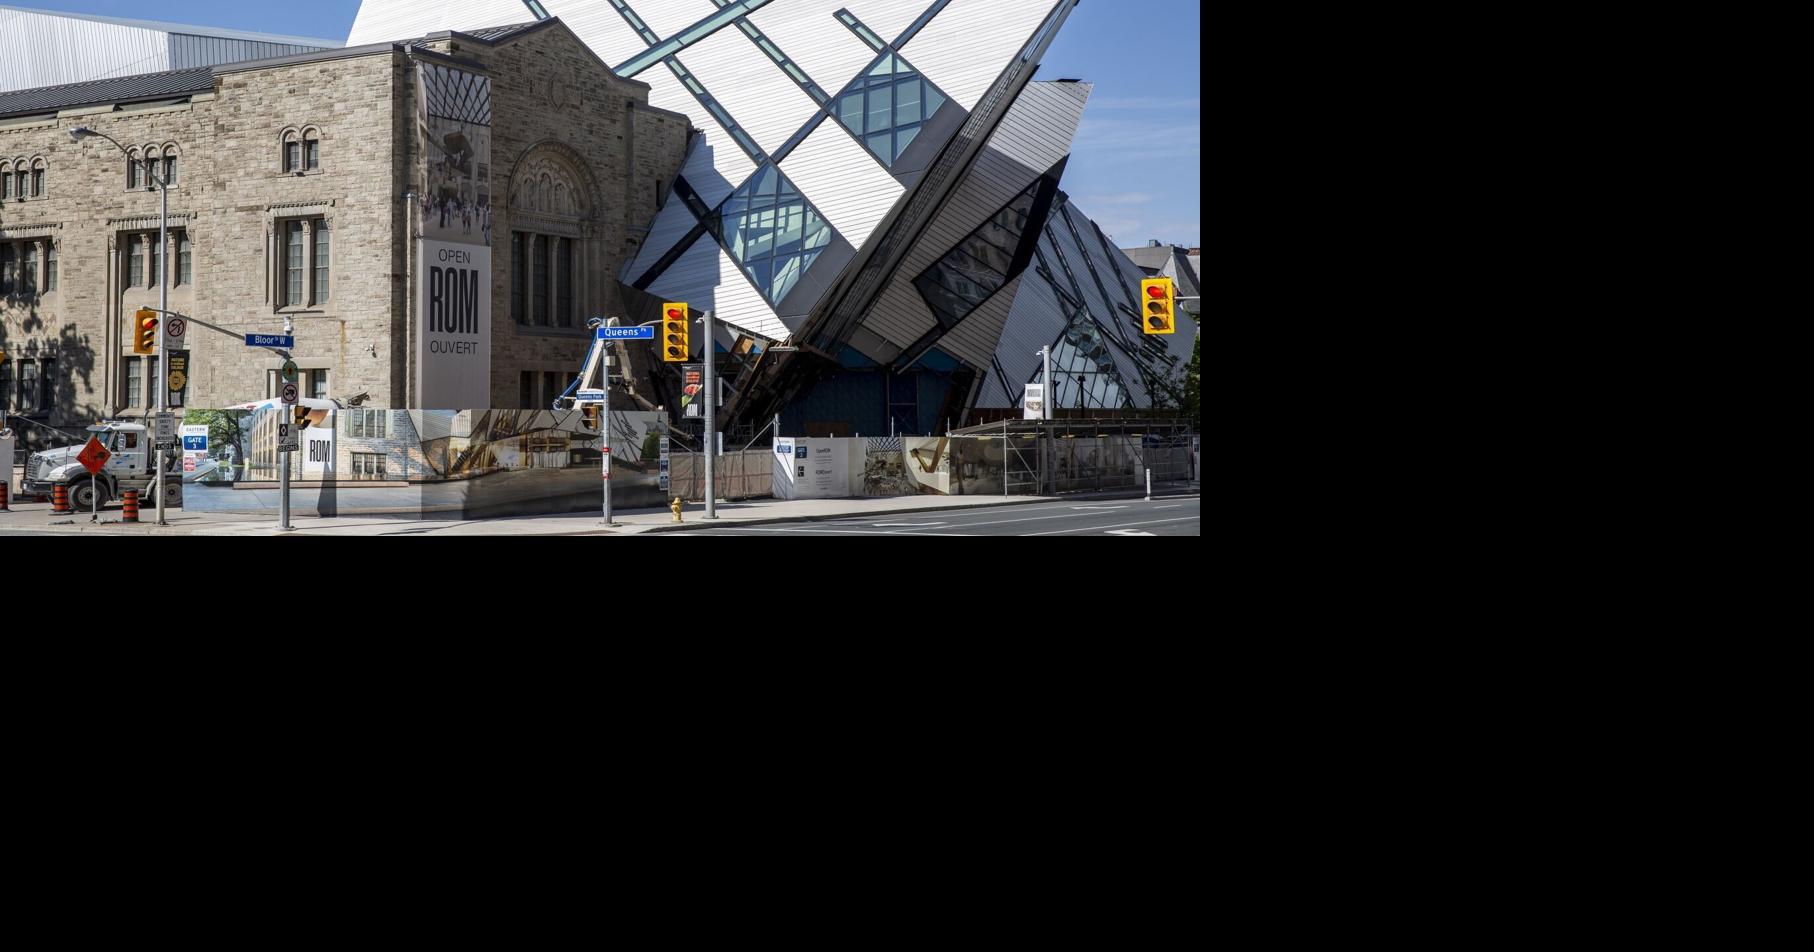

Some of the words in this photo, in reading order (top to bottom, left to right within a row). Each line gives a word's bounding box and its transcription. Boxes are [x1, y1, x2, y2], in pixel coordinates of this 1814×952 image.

[438, 248, 470, 264] OPEN
[430, 266, 478, 334] ROM
[255, 335, 274, 344] Bloor
[604, 328, 639, 337] Queens
[430, 340, 478, 354] OUVERT
[686, 404, 698, 416] ROM
[310, 440, 330, 462] ROM
